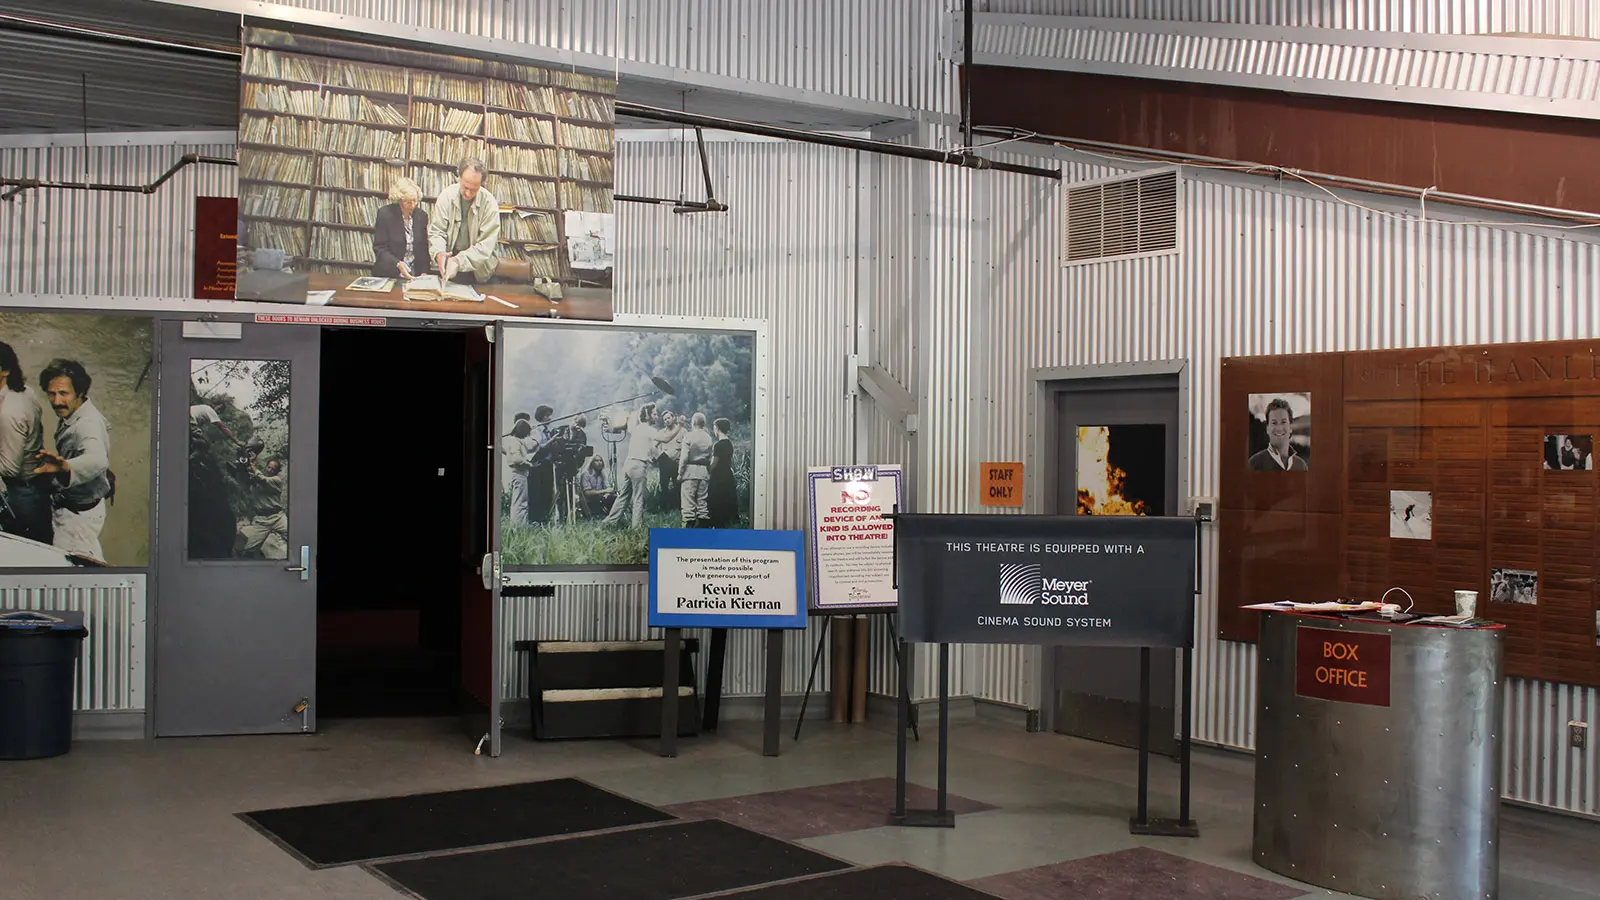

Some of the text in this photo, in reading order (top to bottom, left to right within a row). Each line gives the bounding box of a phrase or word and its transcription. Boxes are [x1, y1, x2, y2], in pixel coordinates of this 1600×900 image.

[1393, 359, 1456, 387] THE
[833, 467, 875, 481] SHOW
[989, 469, 1014, 480] STAFF
[989, 486, 1014, 498] ONLY
[831, 505, 881, 513] RECORDING
[823, 515, 854, 523] DEVICE
[946, 542, 1145, 554] THIS THEATRE IS EQUIPPED WITH A
[702, 583, 755, 596] Kevin &
[1041, 578, 1089, 593] Meyer
[676, 597, 781, 610] Patricia Kiernan
[1041, 592, 1089, 606] Sound
[977, 616, 1112, 628] CINEMA SOUND SYSTEM
[1323, 641, 1359, 661] BOX
[1315, 666, 1368, 688] OFFICE
